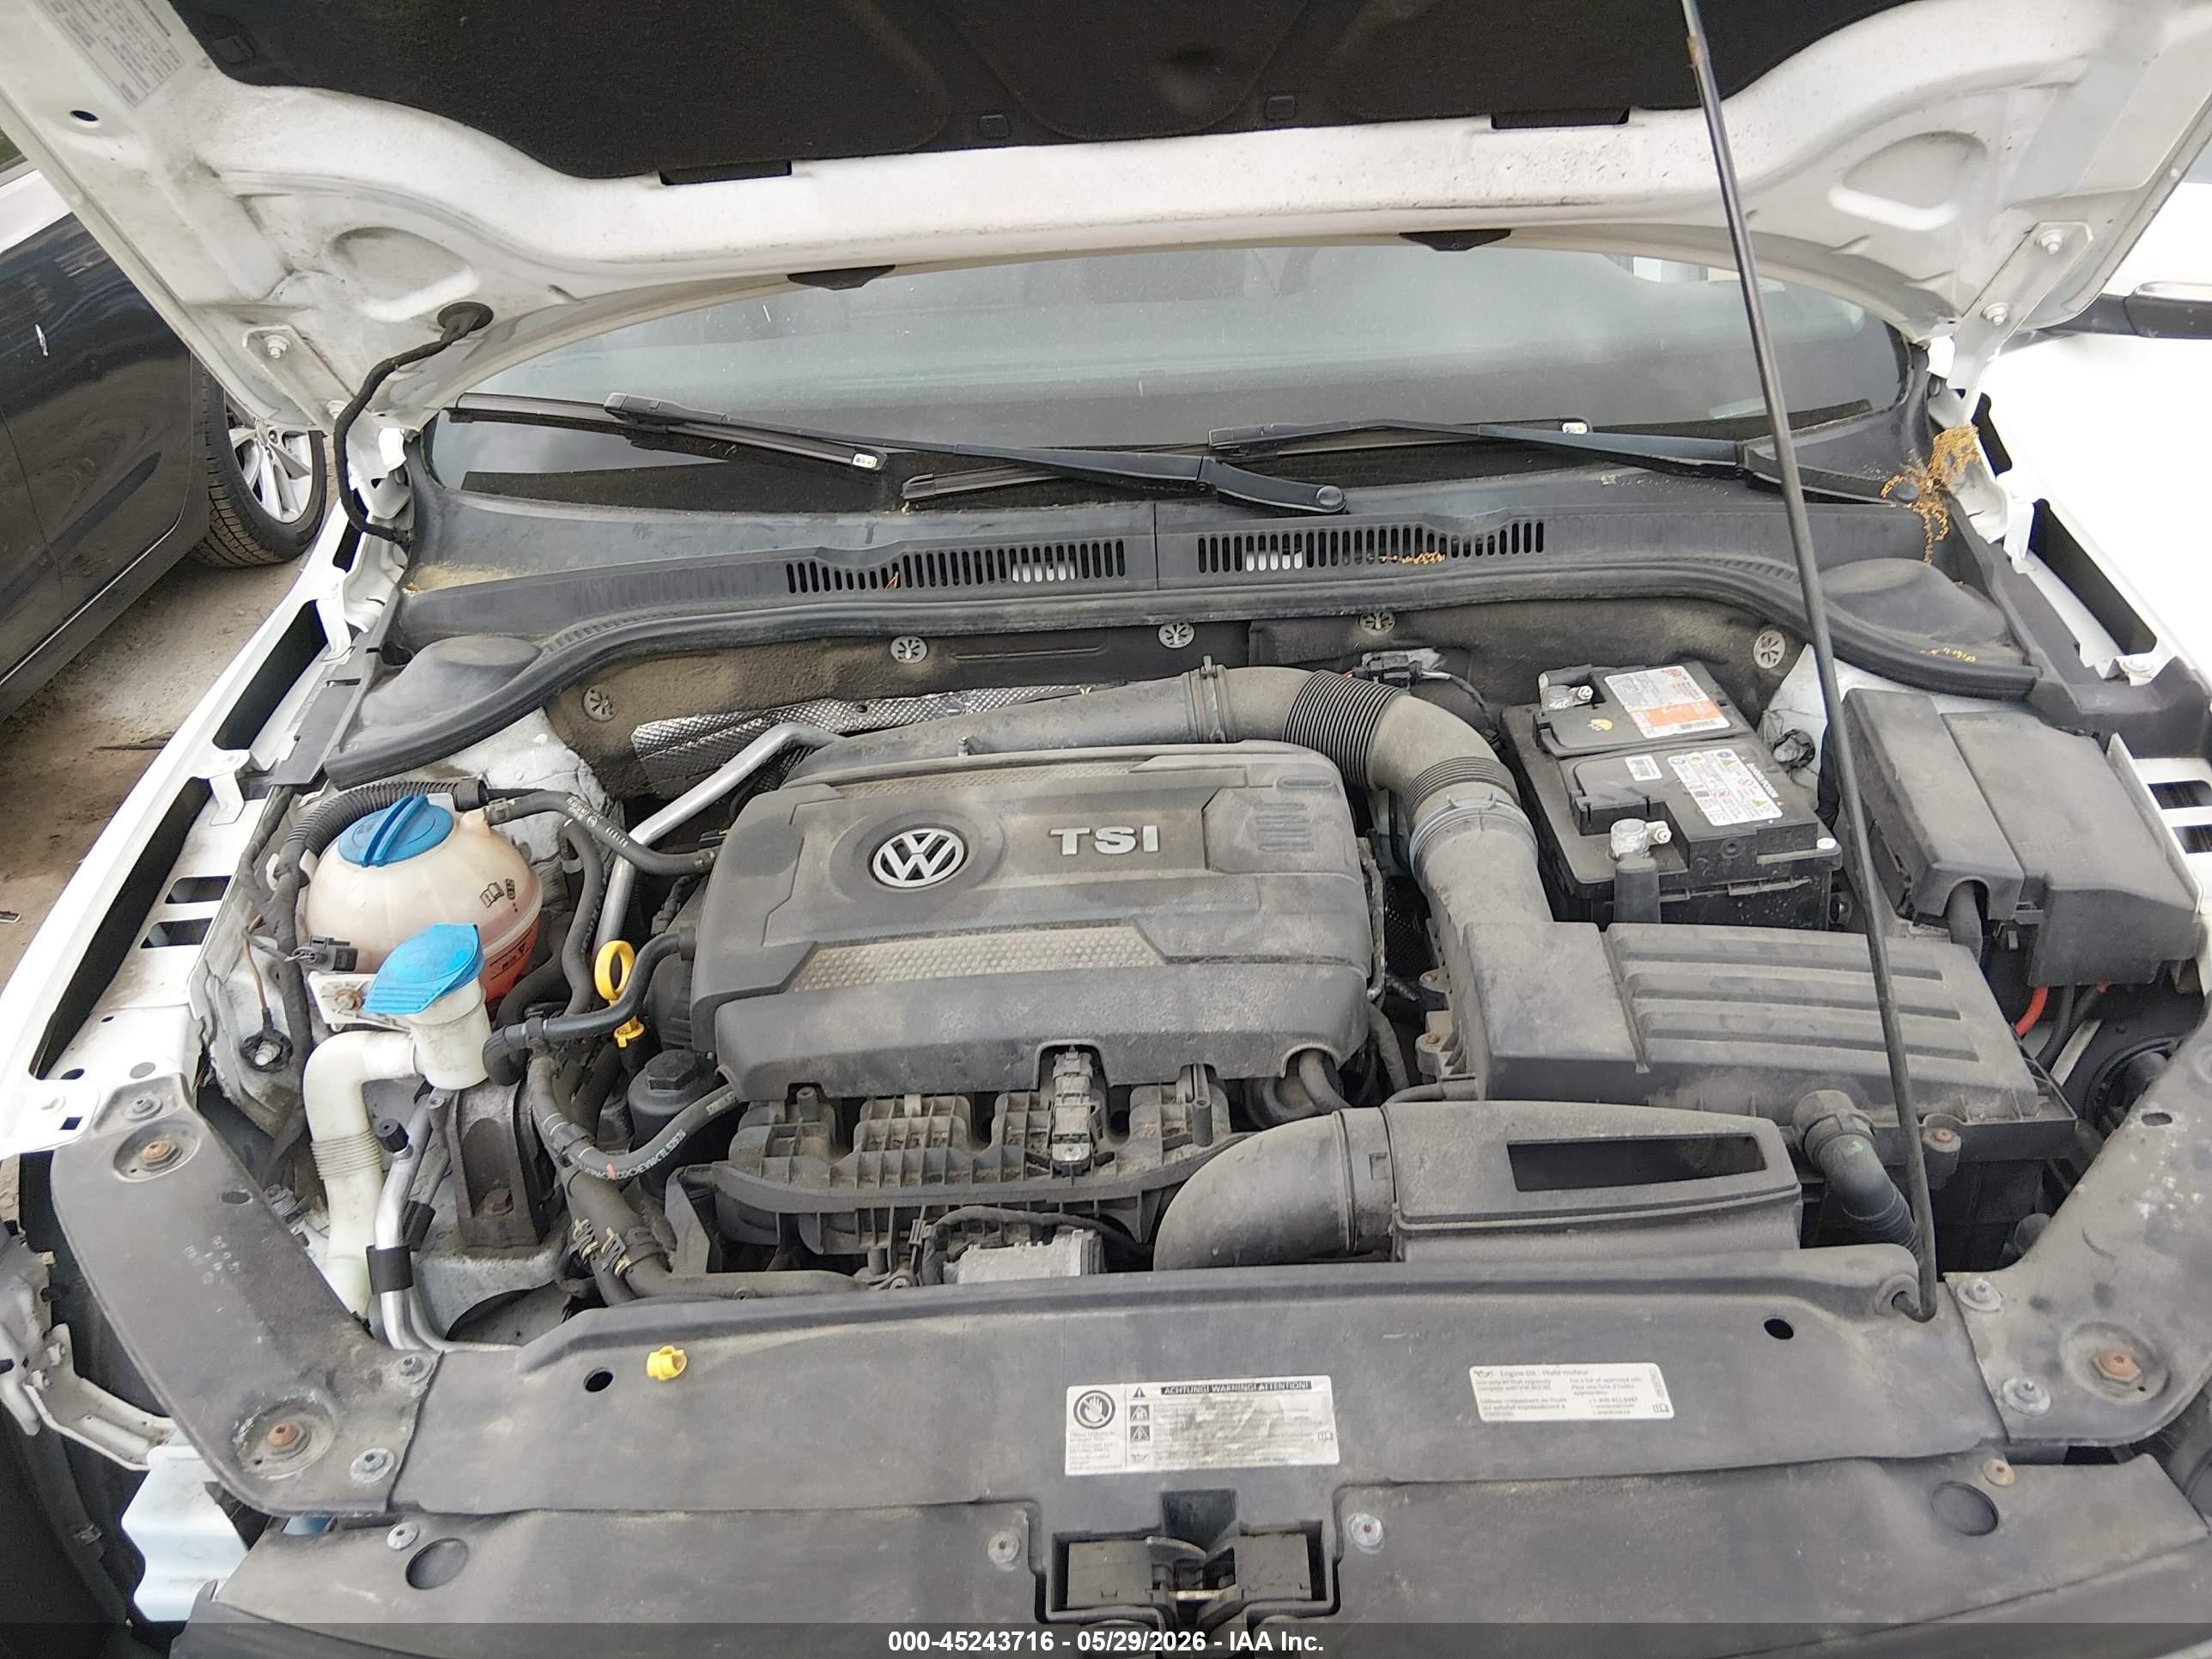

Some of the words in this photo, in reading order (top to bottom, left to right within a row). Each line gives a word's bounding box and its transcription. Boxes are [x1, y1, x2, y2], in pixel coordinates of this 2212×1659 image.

[1049, 824, 1159, 856] TSI
[1164, 1384, 1210, 1395] ACHTUNG!
[1211, 1382, 1257, 1393] WARNING!
[1258, 1380, 1309, 1391] ATTENTION!
